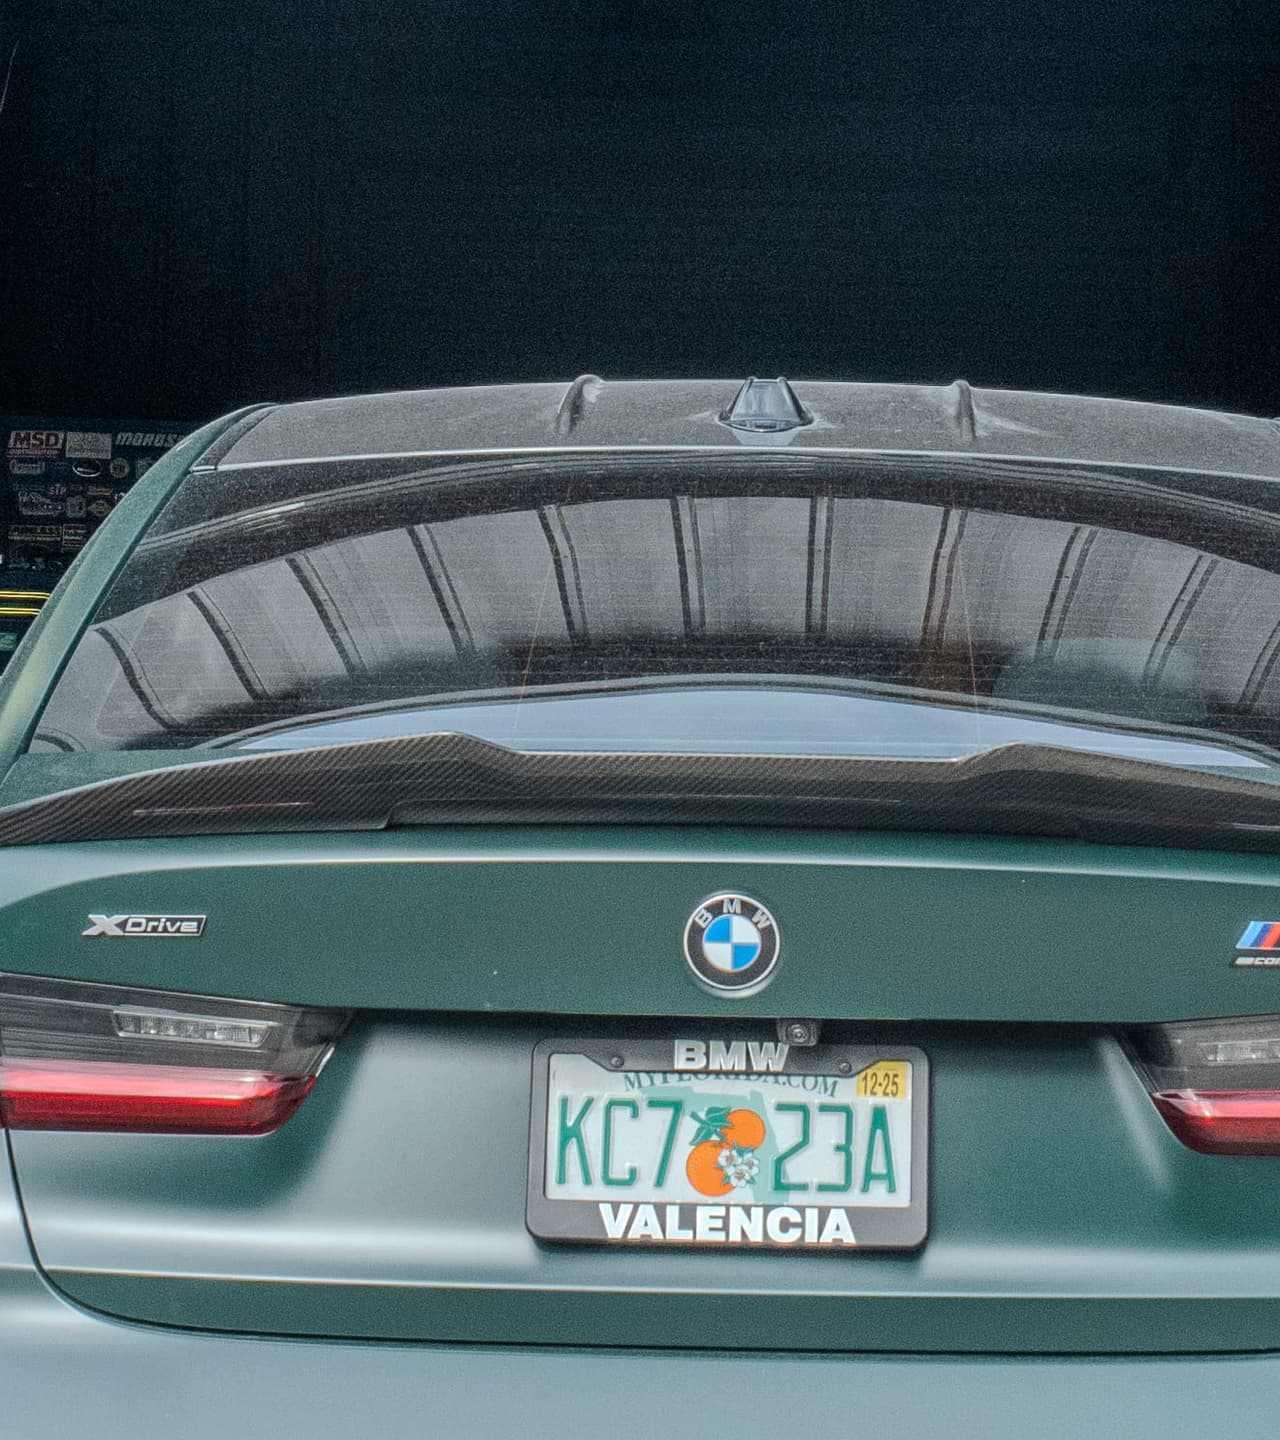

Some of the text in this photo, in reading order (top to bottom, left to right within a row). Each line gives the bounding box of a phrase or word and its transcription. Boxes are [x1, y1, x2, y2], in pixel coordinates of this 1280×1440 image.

[694, 897, 772, 929] BMW
[673, 1039, 790, 1072] BMW
[556, 1095, 897, 1195] KC7 23A
[599, 1203, 856, 1244] VALENCIA
